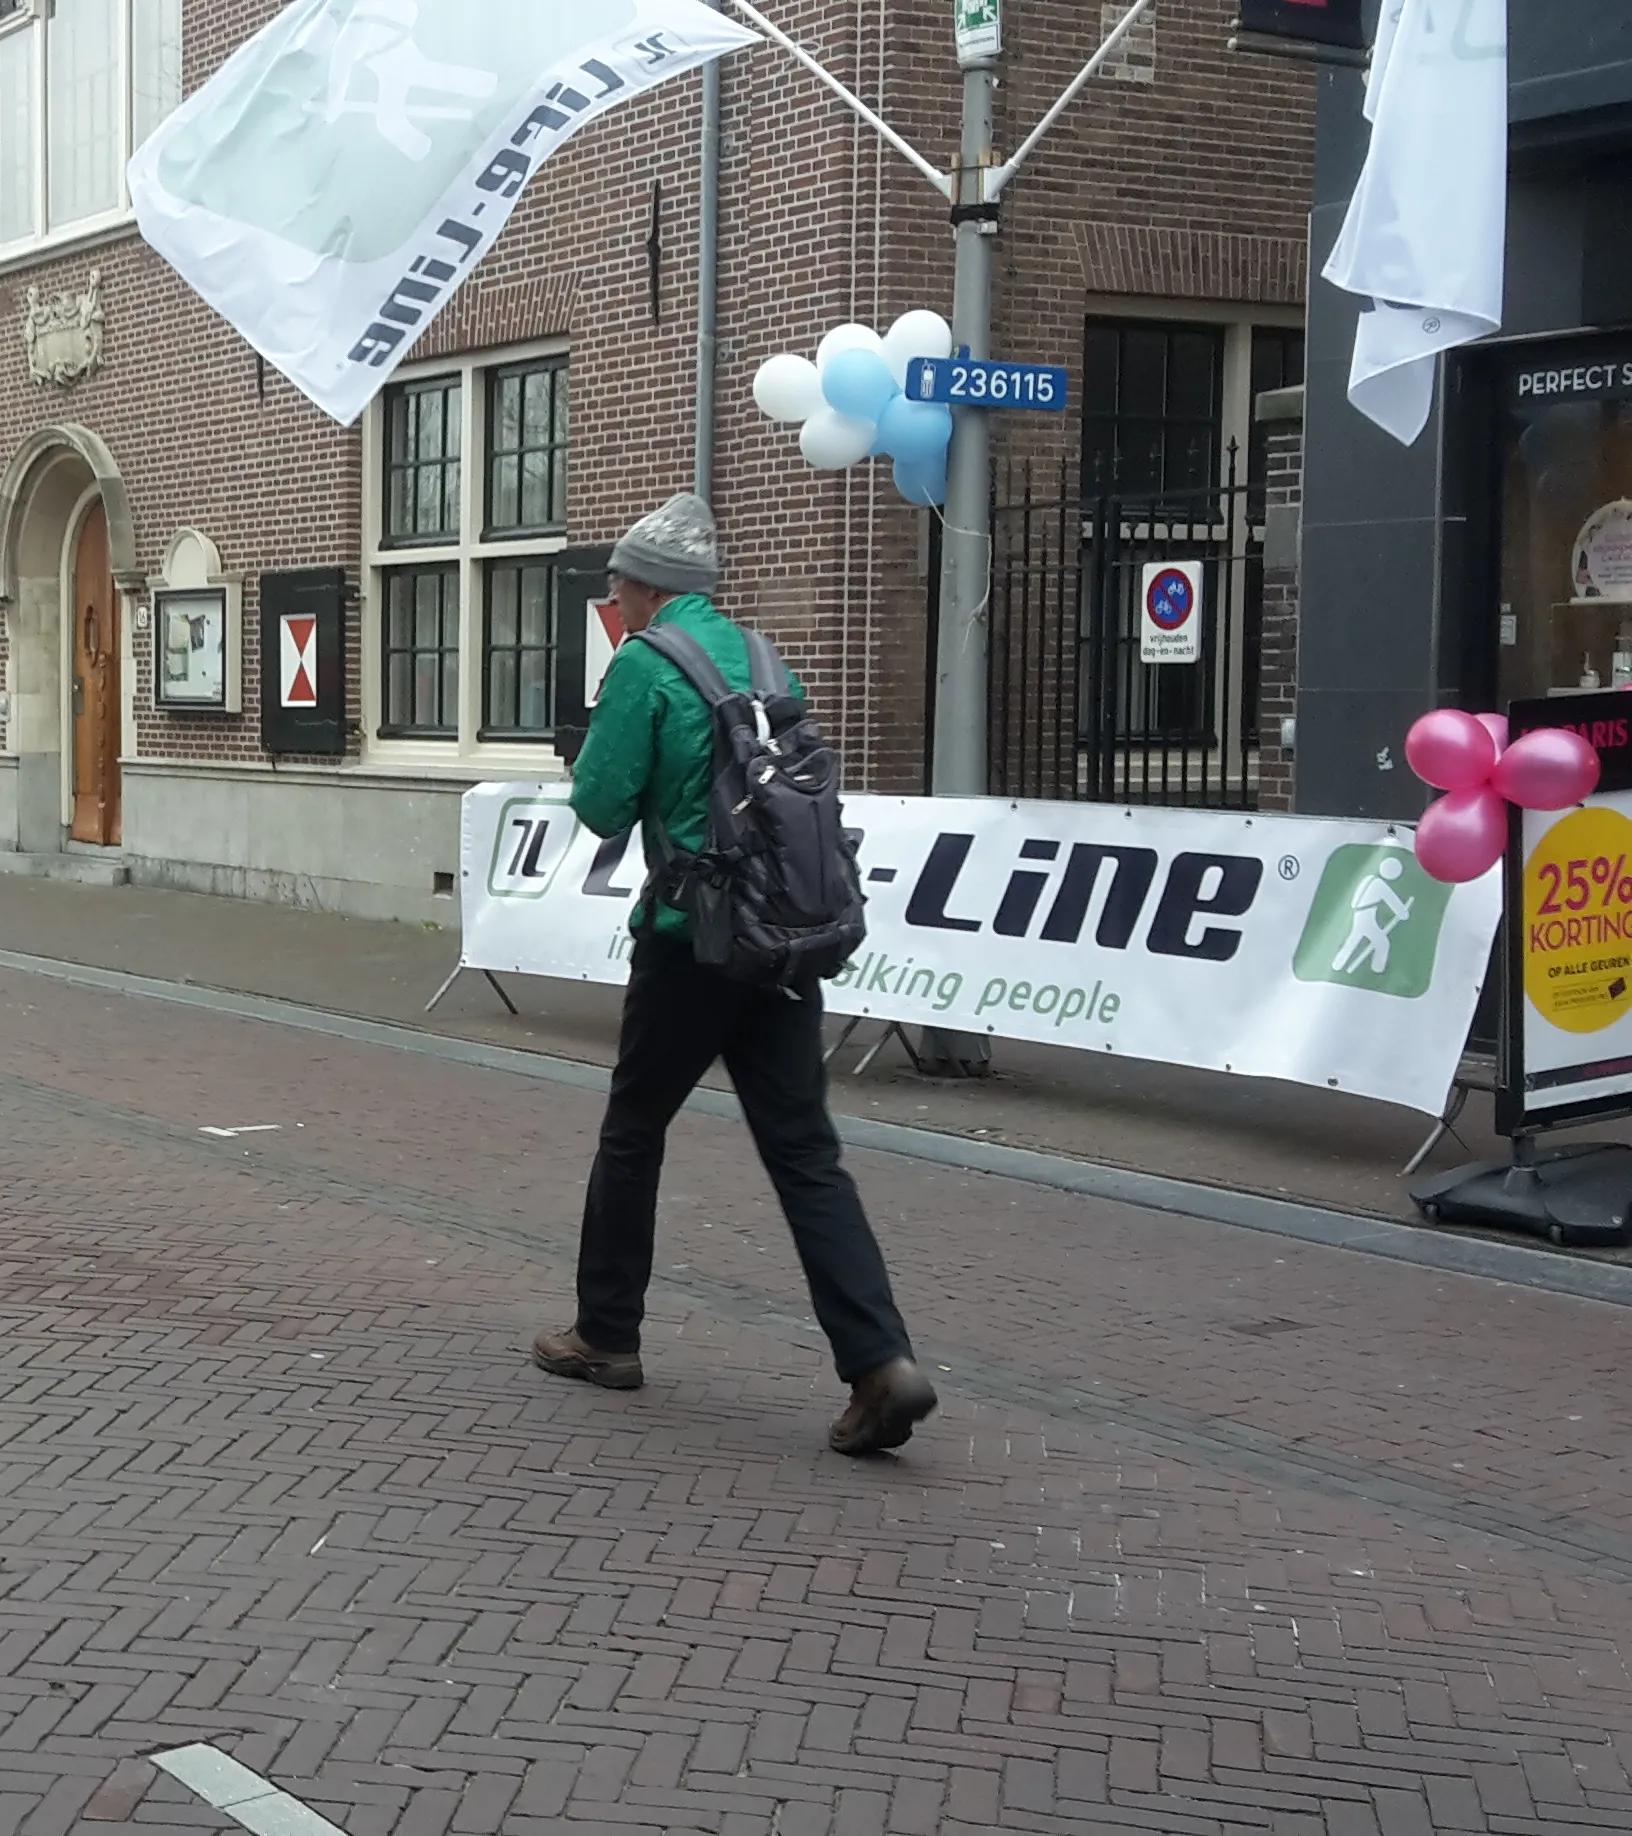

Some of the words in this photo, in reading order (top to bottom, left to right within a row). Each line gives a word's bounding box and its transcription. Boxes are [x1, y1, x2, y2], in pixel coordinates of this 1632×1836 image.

[949, 366, 1055, 403] 236115
[1518, 364, 1618, 397] PERFECT
[1149, 634, 1188, 646] vrijhouden
[1537, 853, 1632, 916] 25%
[831, 951, 964, 1011] alking
[974, 970, 1121, 1028] people
